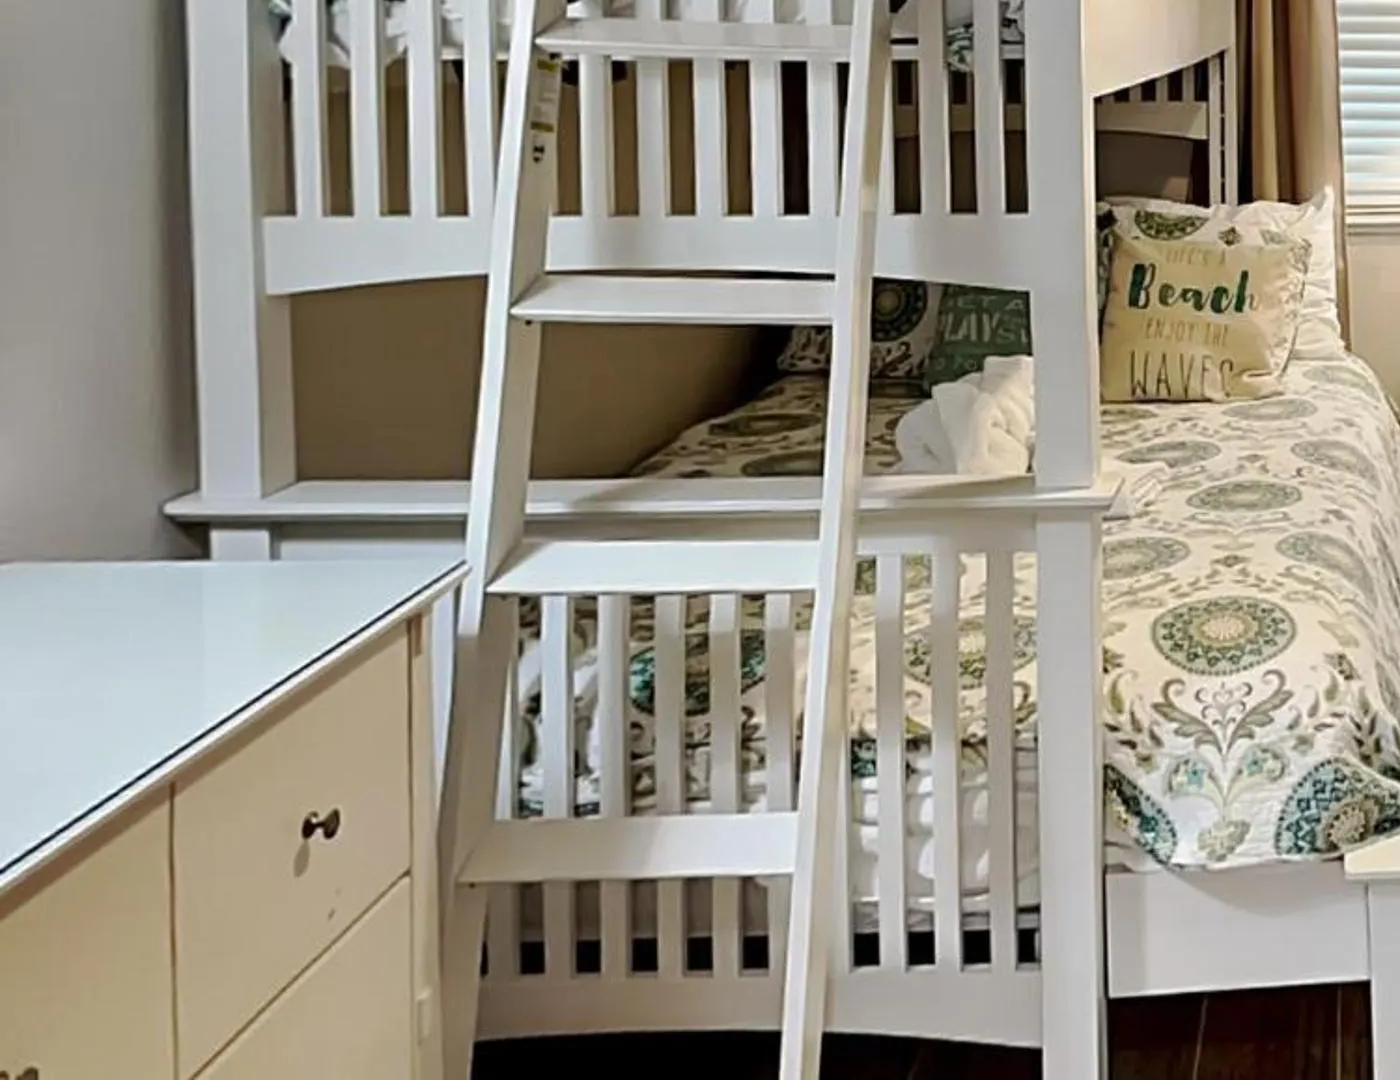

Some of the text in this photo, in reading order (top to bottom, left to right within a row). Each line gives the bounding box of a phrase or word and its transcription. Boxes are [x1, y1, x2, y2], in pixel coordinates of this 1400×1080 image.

[1128, 262, 1262, 314] Beach
[1145, 317, 1230, 347] ENJOY THE
[1129, 349, 1236, 399] WAVES
